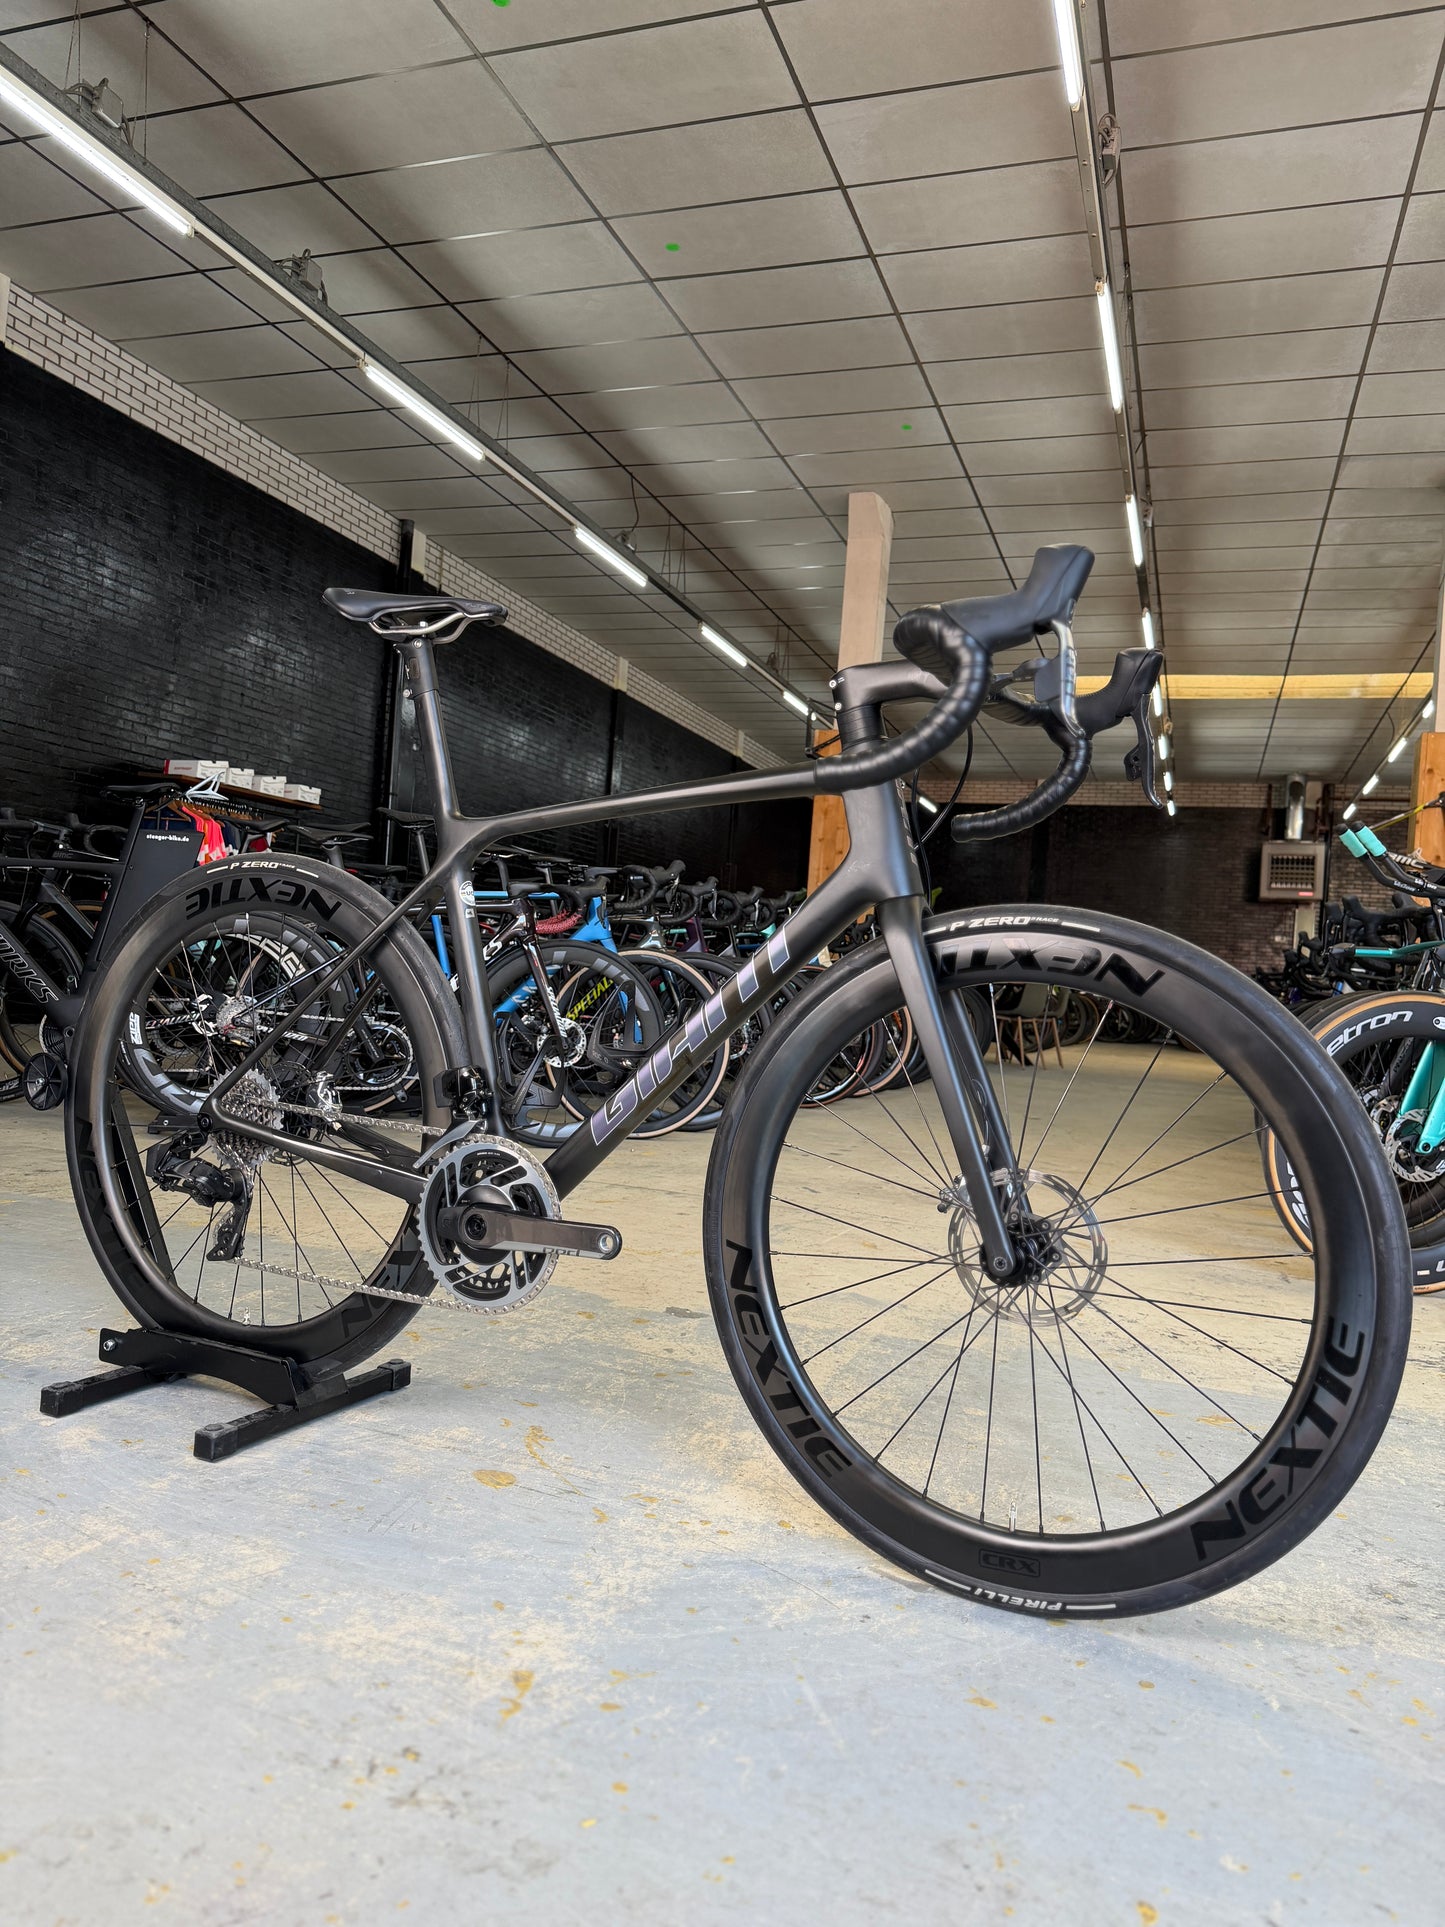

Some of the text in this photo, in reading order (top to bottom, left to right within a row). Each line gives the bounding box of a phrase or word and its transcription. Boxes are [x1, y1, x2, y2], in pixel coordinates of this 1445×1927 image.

[230, 862, 240, 870] P
[241, 860, 279, 869] ZERO
[185, 877, 342, 921] NEXTIE
[949, 920, 965, 932] P
[967, 916, 1031, 929] ZERO
[938, 937, 1166, 997] NEXTI
[590, 893, 808, 1146] GIANT
[1326, 1010, 1413, 1057] etron
[726, 1239, 852, 1478] NEXTIE
[1190, 1315, 1366, 1562] NEXTIE
[982, 1552, 1038, 1575] CRX
[973, 1587, 1063, 1611] PIRELLI
